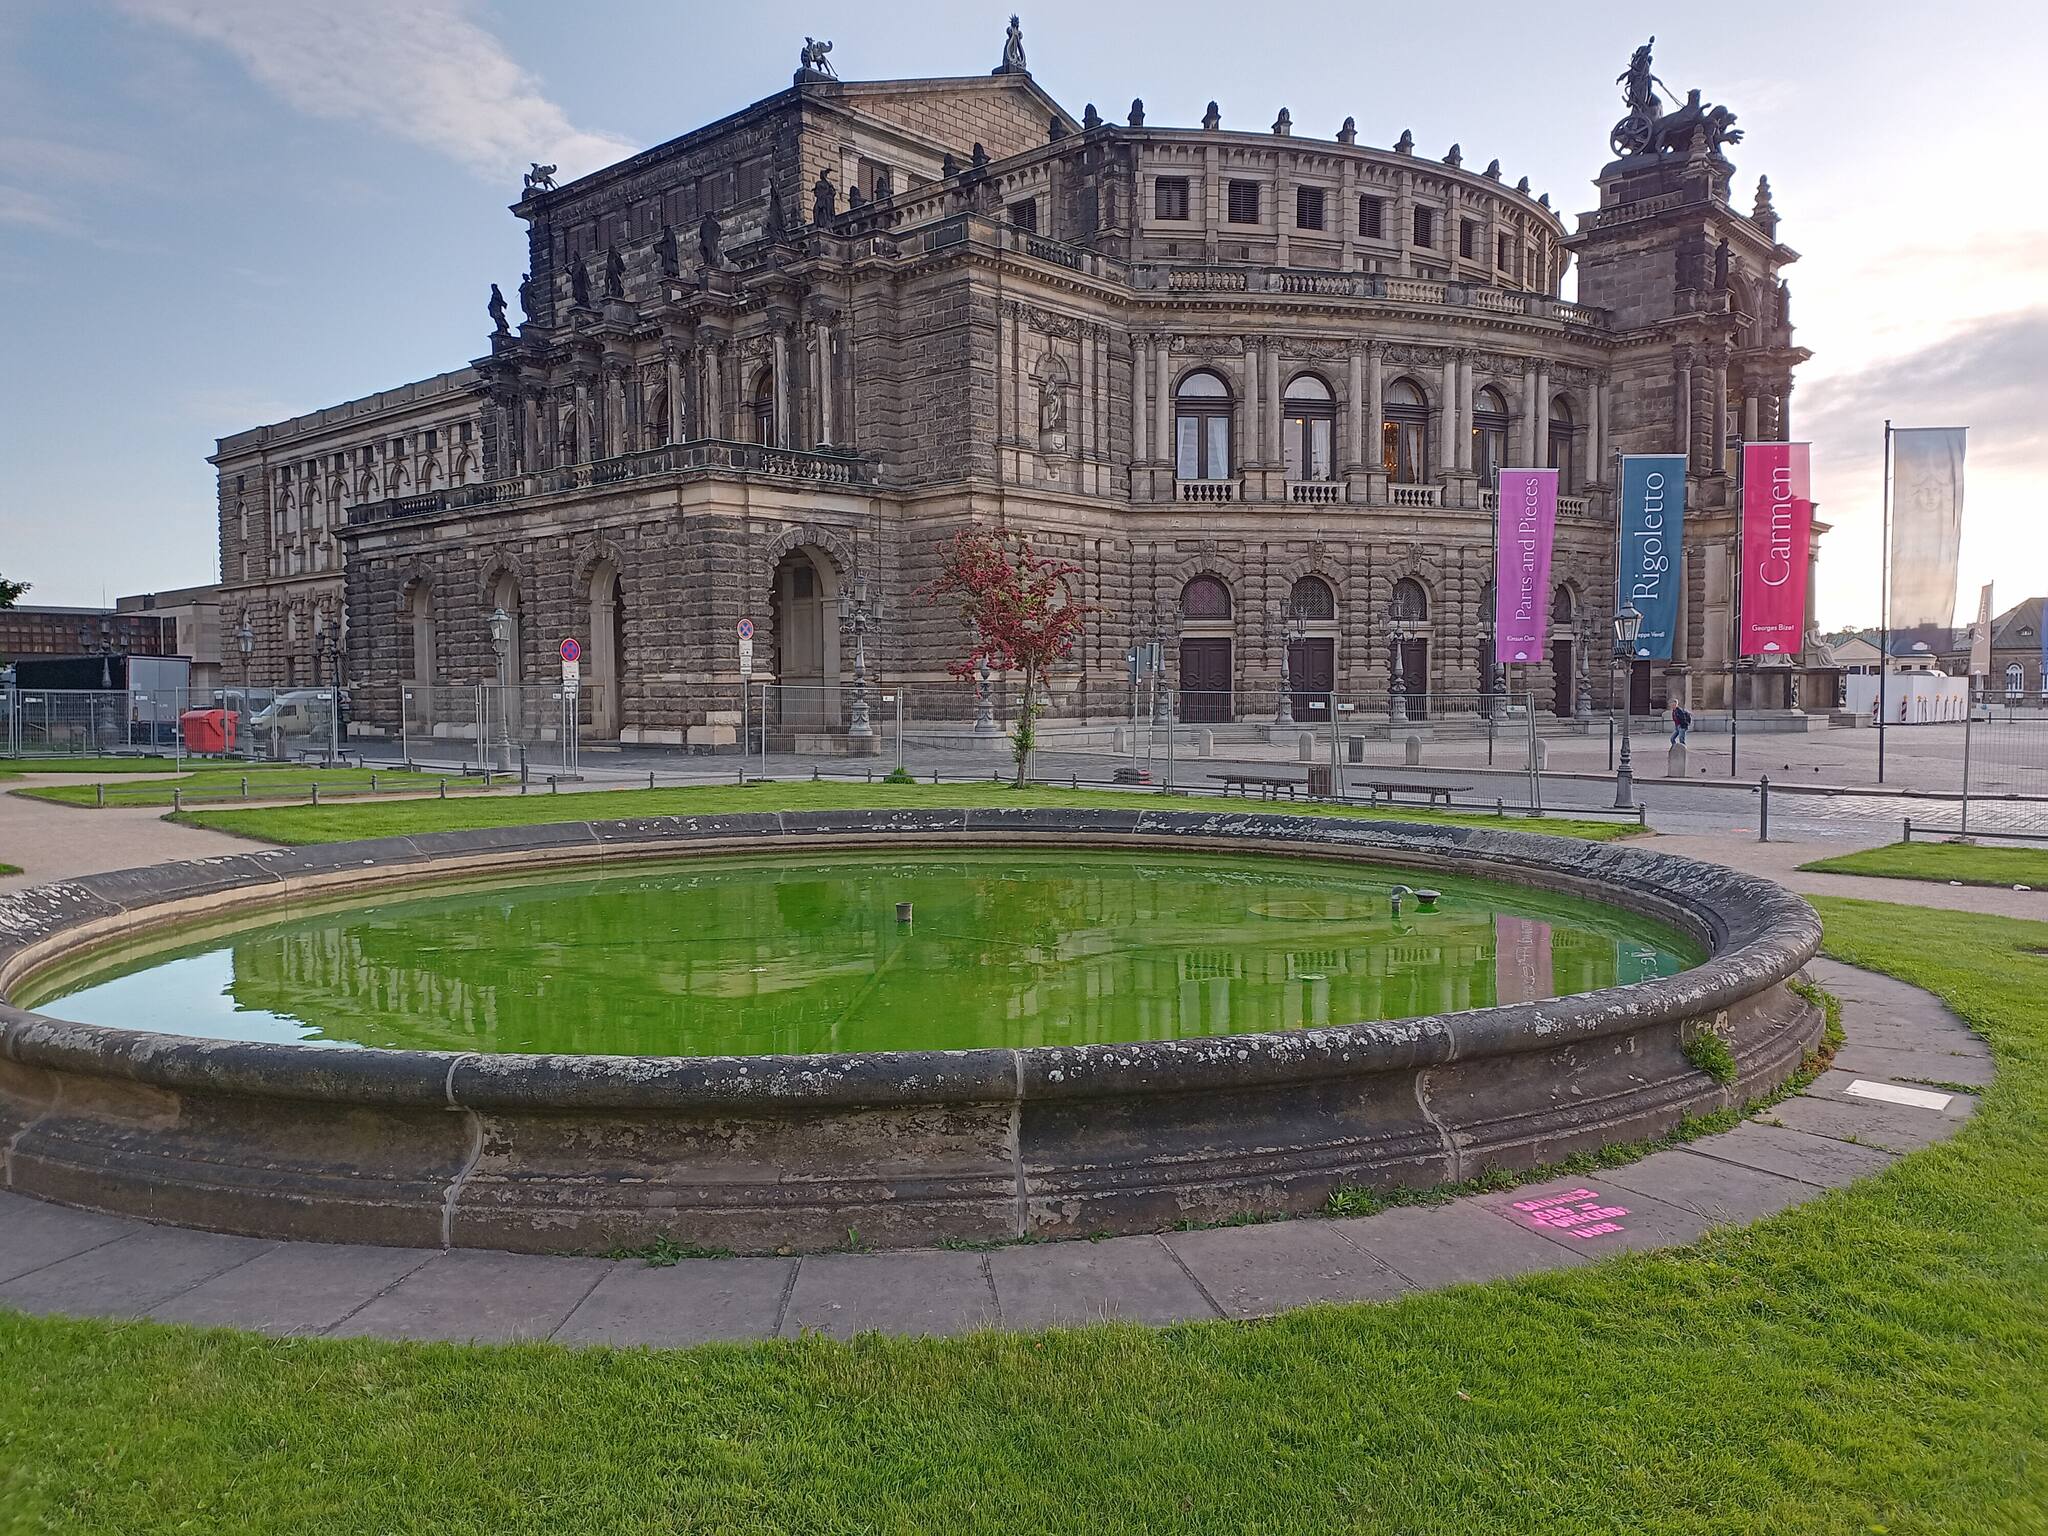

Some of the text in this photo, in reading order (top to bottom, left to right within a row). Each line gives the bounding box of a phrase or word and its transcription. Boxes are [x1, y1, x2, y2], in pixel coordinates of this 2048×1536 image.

[1515, 478, 1539, 621] Parts and Pieces
[1632, 472, 1669, 600] Rigoletto
[1760, 466, 1792, 586] Carmen
[1751, 623, 1795, 633] Georges Bizet
